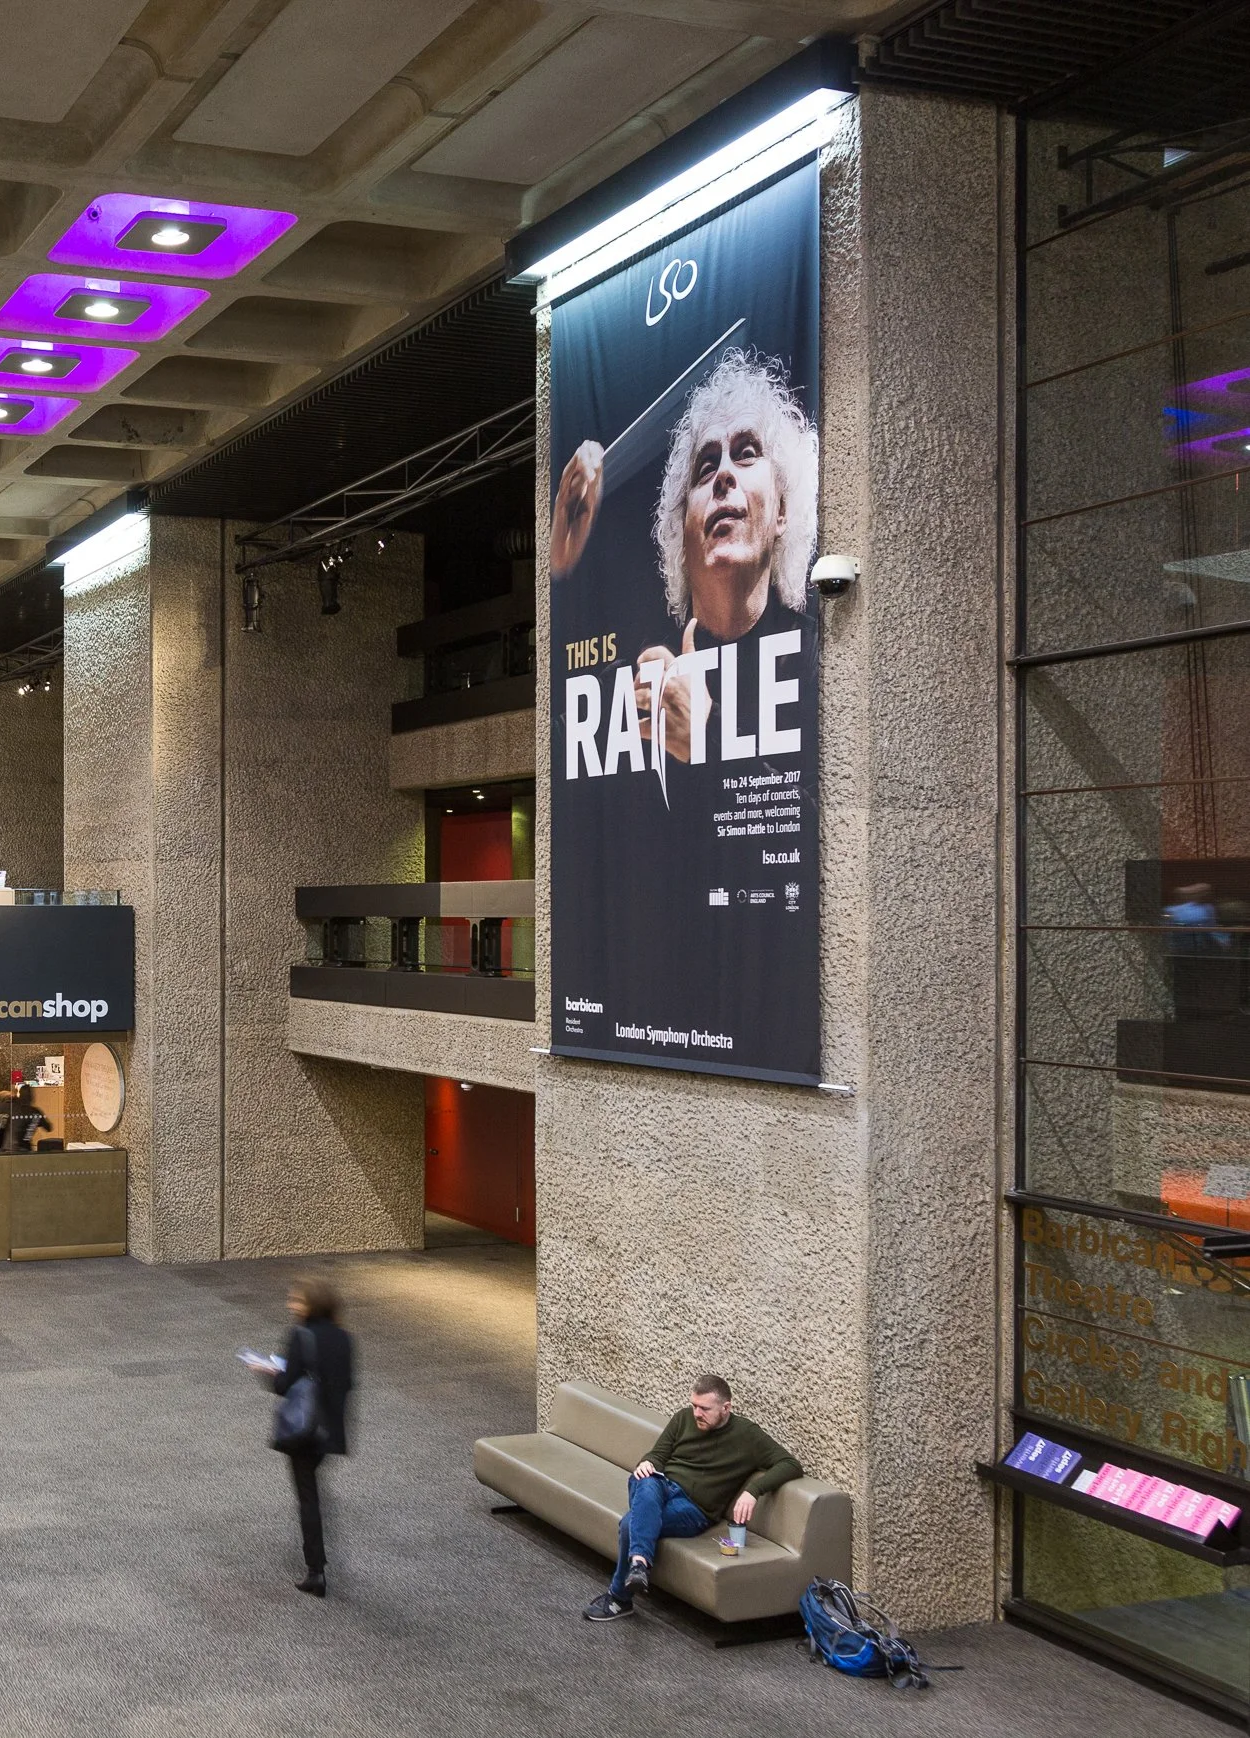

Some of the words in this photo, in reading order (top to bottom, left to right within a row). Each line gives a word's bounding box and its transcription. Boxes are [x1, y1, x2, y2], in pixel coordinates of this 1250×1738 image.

[645, 259, 698, 327] LSO
[566, 638, 598, 671] THIS
[602, 632, 617, 662] IS
[565, 629, 801, 811] RATTLE
[723, 778, 730, 789] 14
[731, 778, 738, 789] to
[739, 777, 748, 788] 24
[749, 773, 783, 789] September
[784, 771, 801, 784] 2017
[713, 811, 733, 822] events
[734, 808, 746, 820] and
[747, 810, 764, 820] more,
[765, 804, 801, 818] welcoming
[735, 793, 747, 804] Ten
[748, 792, 762, 805] days
[762, 790, 770, 801] of
[770, 789, 801, 800] concerts,
[717, 825, 726, 837] Sir
[726, 825, 746, 836] Simon
[747, 823, 766, 835] Rattle
[766, 824, 774, 833] to
[775, 821, 801, 833] London
[762, 848, 801, 864] lso.co.uk
[565, 996, 603, 1014] barbican
[615, 1022, 646, 1040] London
[646, 1025, 689, 1048] Symphony
[691, 1029, 733, 1050] Orchestra
[1022, 1208, 1177, 1276] Barbican
[1023, 1261, 1155, 1326] Theatre
[1022, 1316, 1142, 1379] Circles
[1158, 1365, 1230, 1403] and
[1022, 1368, 1143, 1441] Gallery
